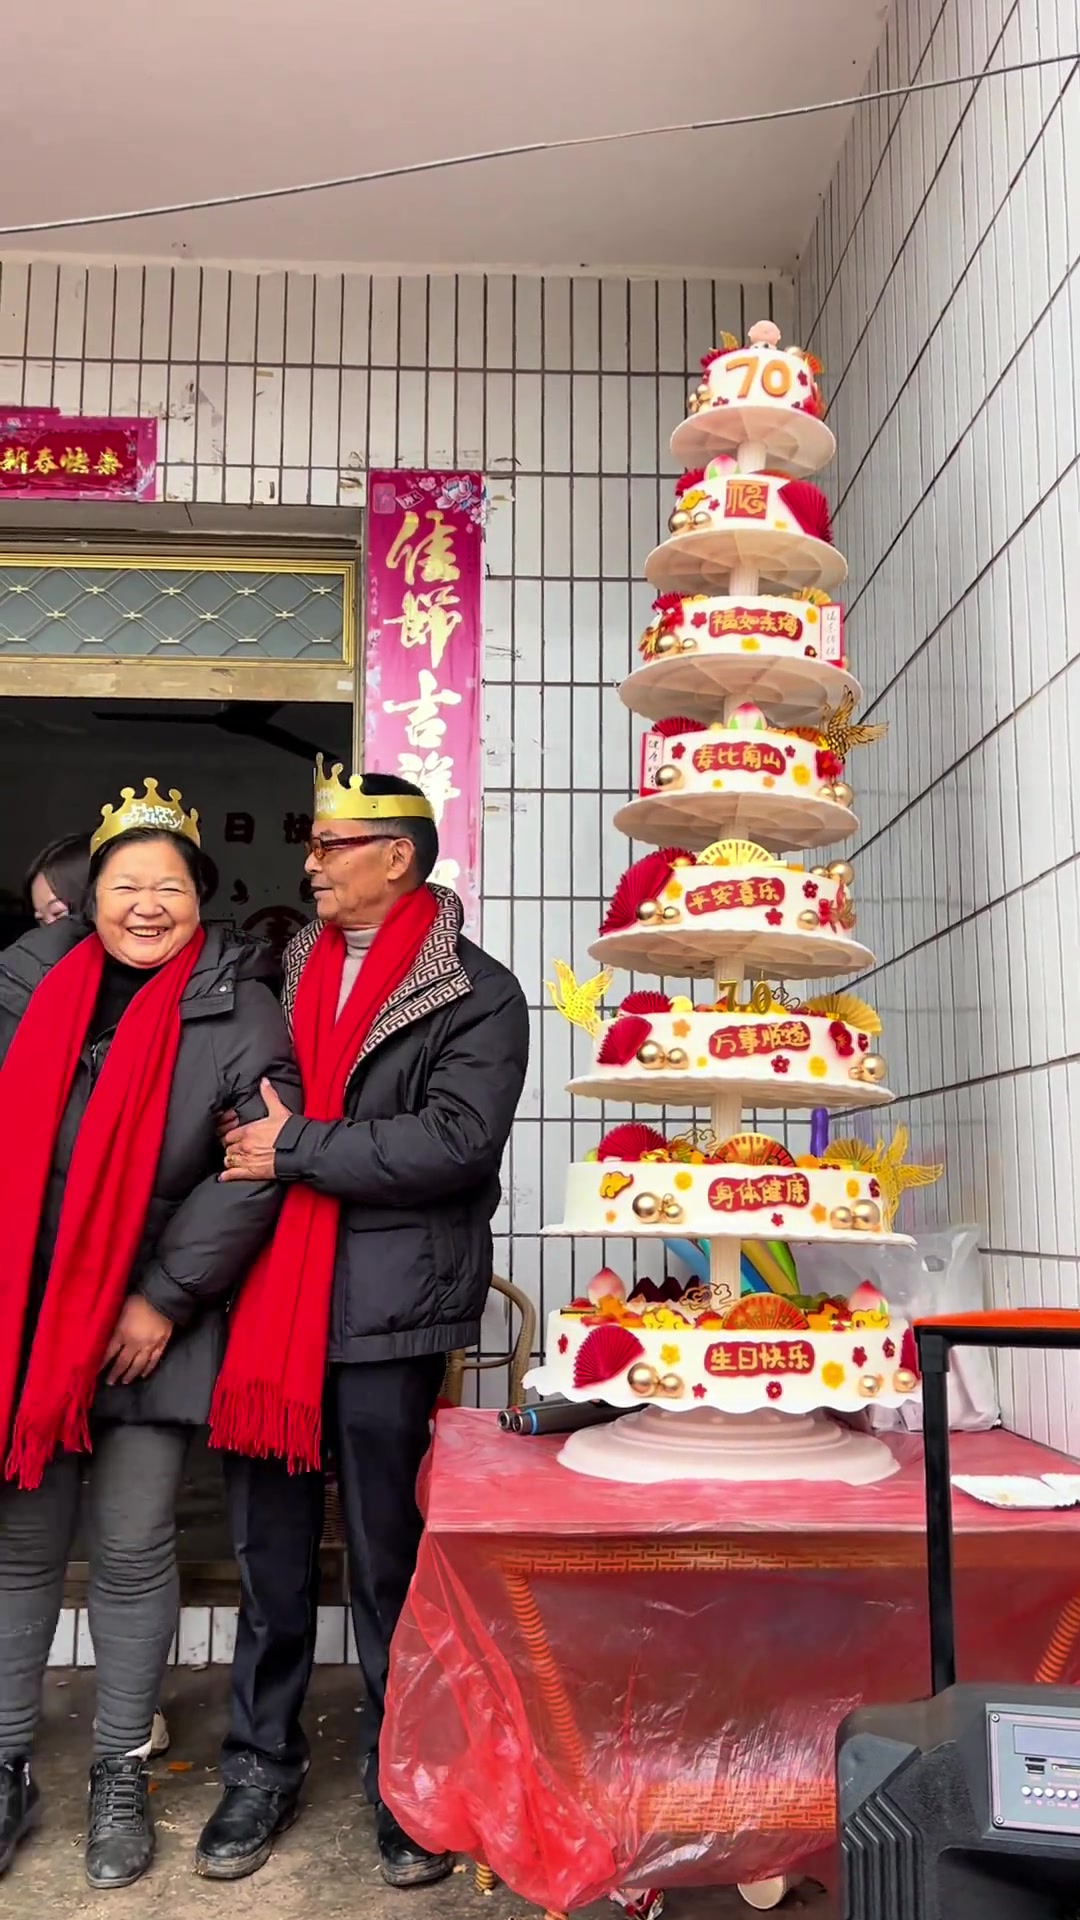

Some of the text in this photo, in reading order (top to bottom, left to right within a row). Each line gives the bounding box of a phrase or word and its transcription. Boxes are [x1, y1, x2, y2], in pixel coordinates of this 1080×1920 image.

[726, 356, 791, 399] 70
[712, 610, 798, 637] 福如东海
[695, 744, 782, 770] 寿比南山
[688, 880, 780, 911] 平安喜乐
[719, 981, 773, 1015] 70
[711, 1174, 808, 1210] 身体健康
[710, 1343, 812, 1372] 生日快乐
